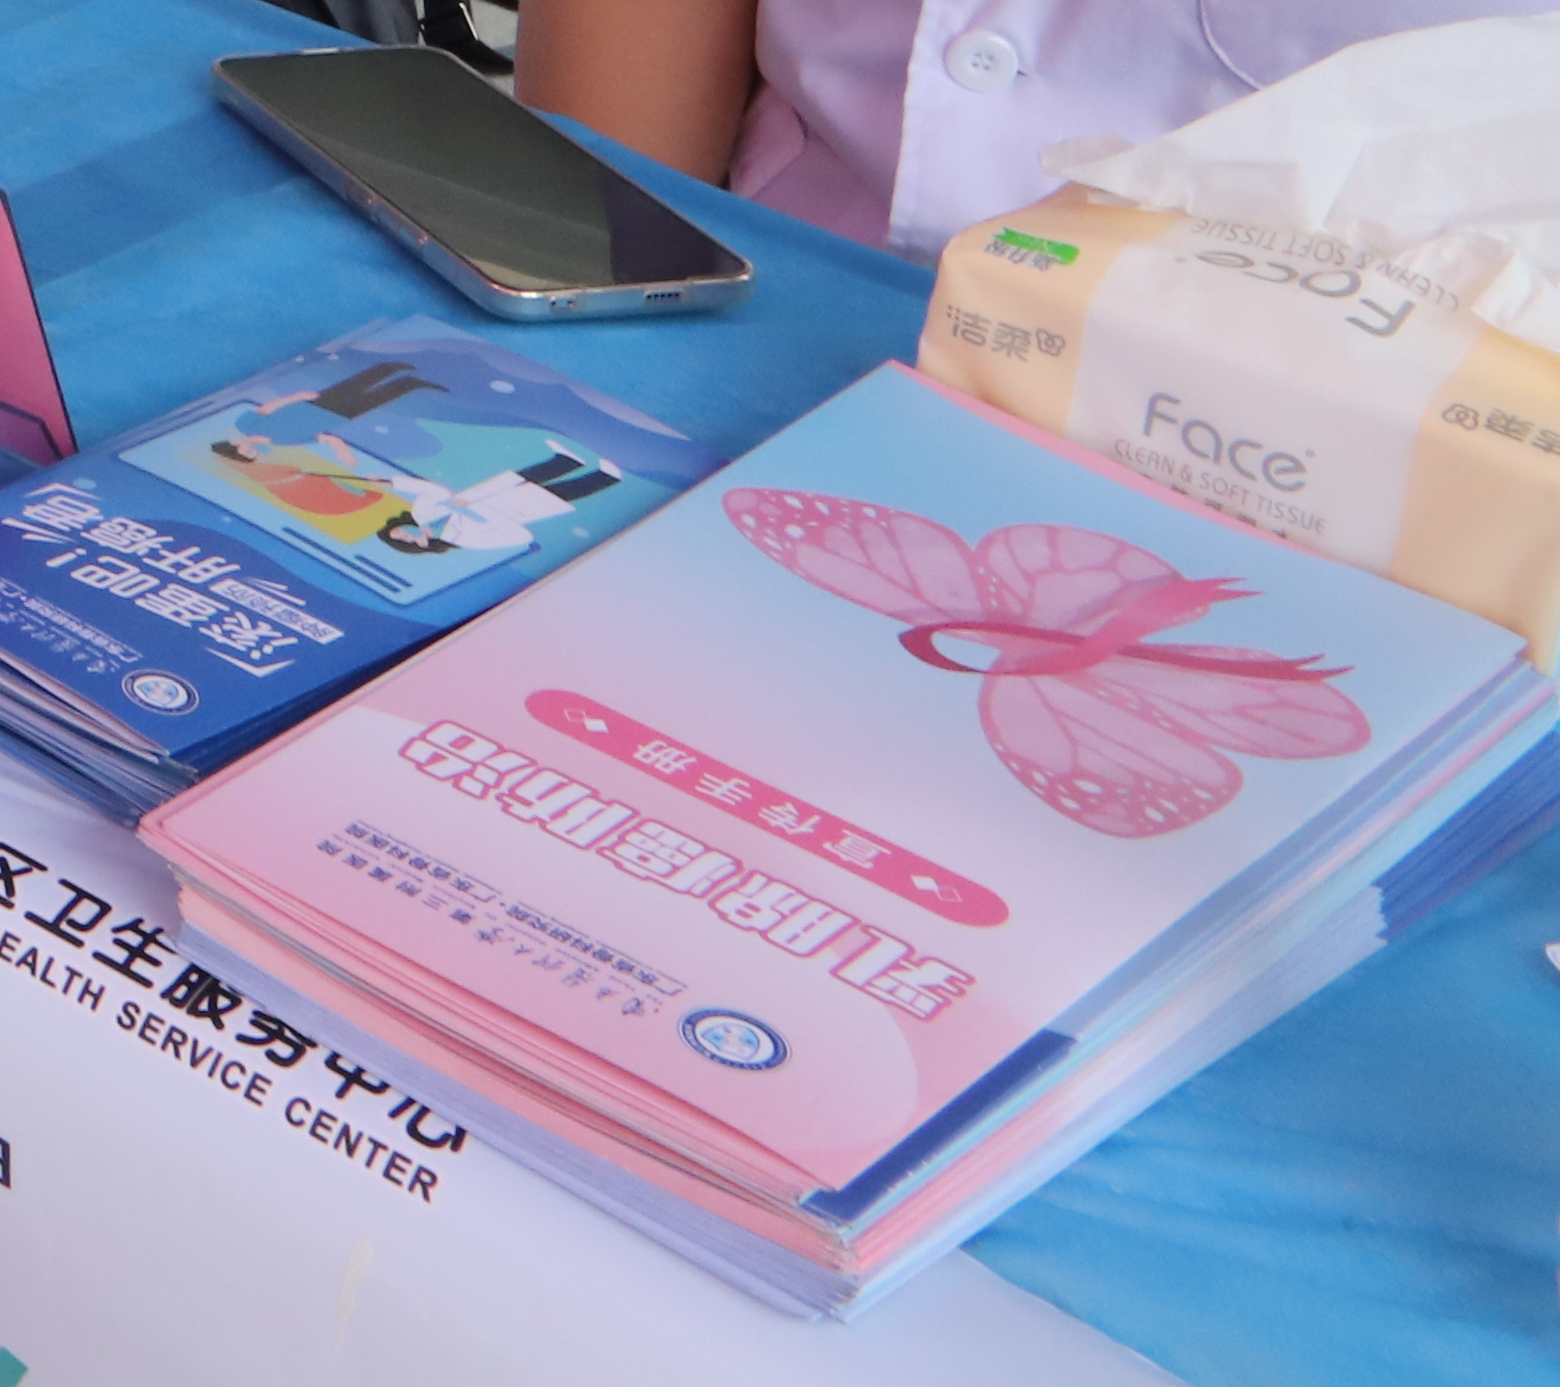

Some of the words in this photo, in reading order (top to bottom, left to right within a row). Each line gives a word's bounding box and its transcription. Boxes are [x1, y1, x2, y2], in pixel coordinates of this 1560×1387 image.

[945, 303, 1033, 364] 洁柔
[1193, 250, 1417, 338] Face
[1114, 438, 1175, 476] CLEAN
[1198, 472, 1251, 507] SOFT
[1256, 495, 1328, 535] TISSUE
[1142, 391, 1308, 492] Face
[23, 493, 242, 585] 肝癌君
[630, 735, 894, 872] 宣传手册
[315, 835, 473, 938] 第三附属医院
[344, 818, 690, 1000] 广东省骨科研究院·广东省骨科医院
[398, 718, 979, 1024] 乳腺癌防治
[116, 1002, 273, 1108] SERVICE
[284, 1095, 440, 1205] CENTER
